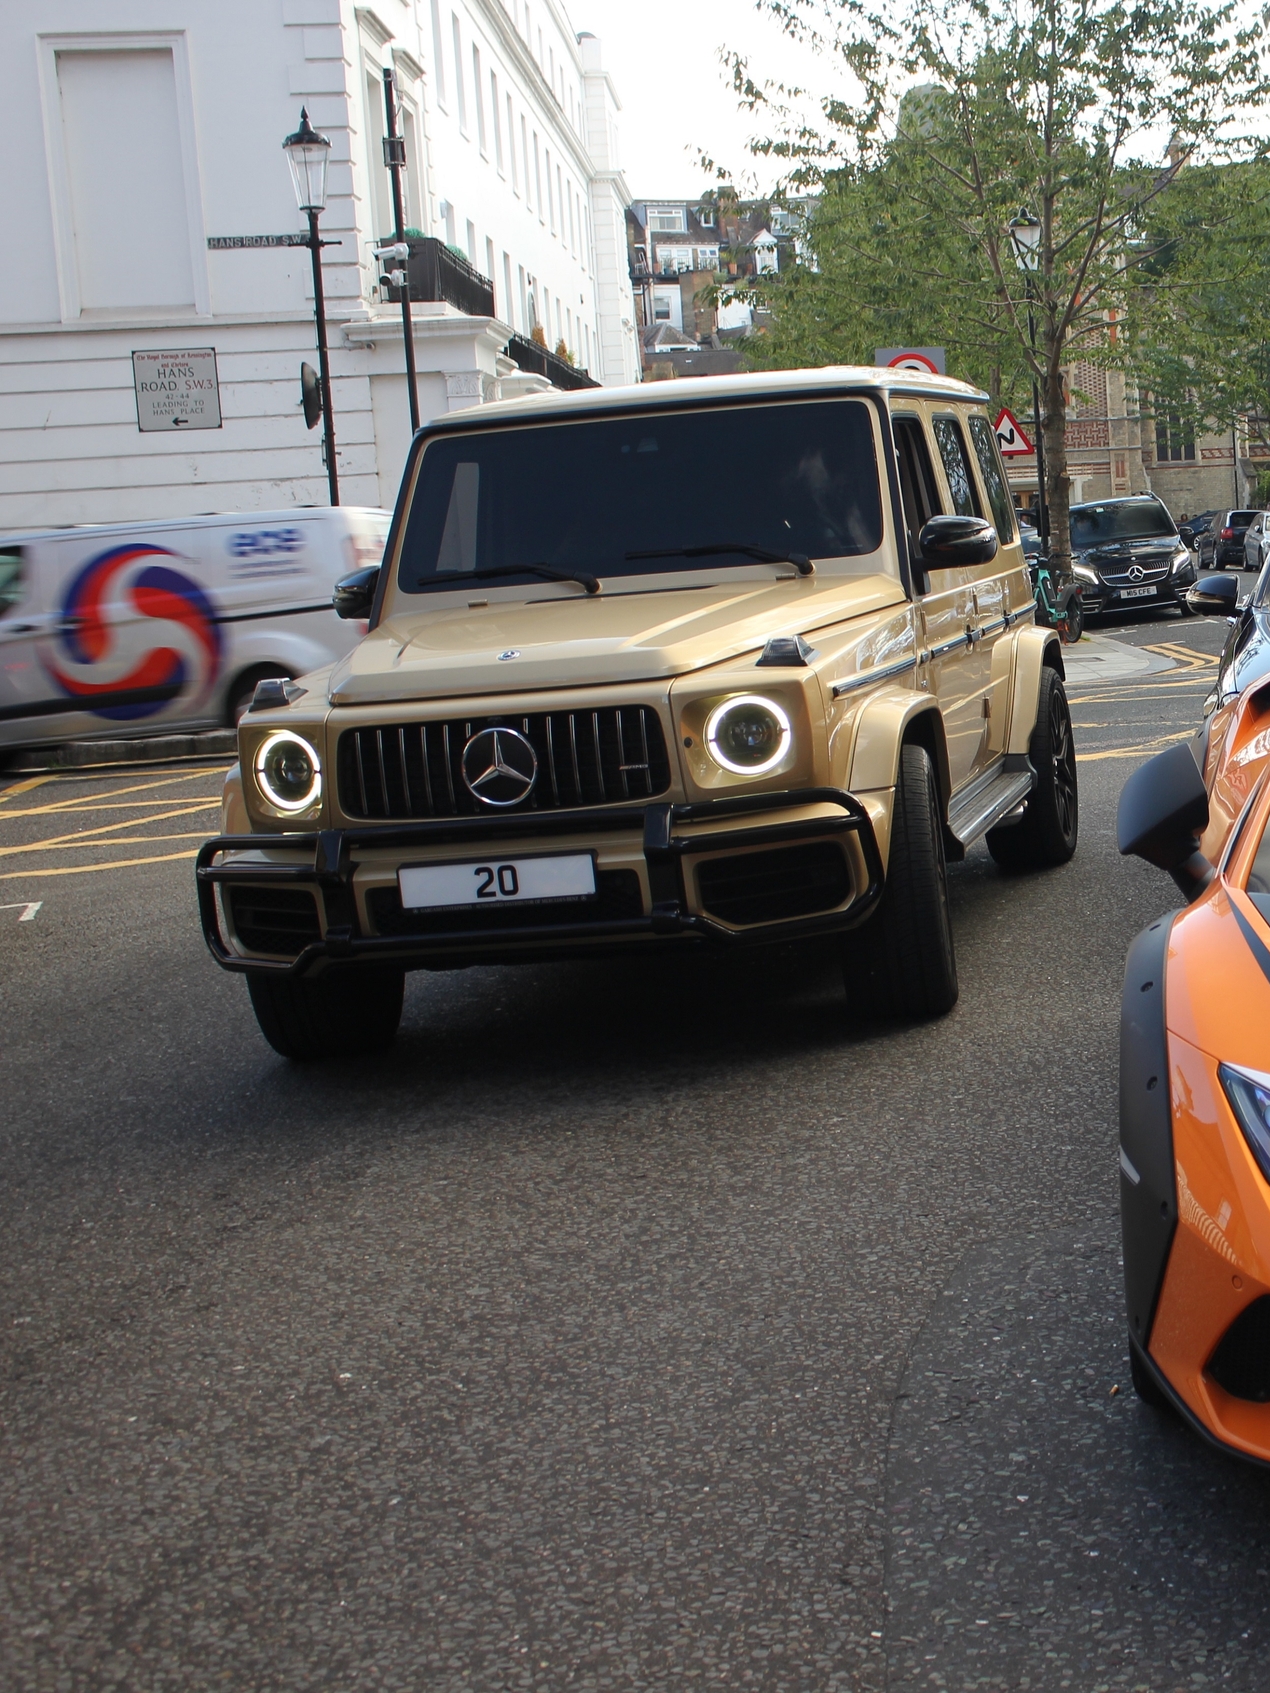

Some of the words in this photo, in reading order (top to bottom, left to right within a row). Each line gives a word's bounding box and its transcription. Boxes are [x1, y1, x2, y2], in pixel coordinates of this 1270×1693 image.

[210, 238, 241, 248] HANS
[245, 236, 276, 246] ROAD
[158, 367, 194, 379] HANS
[474, 864, 519, 898] 20
